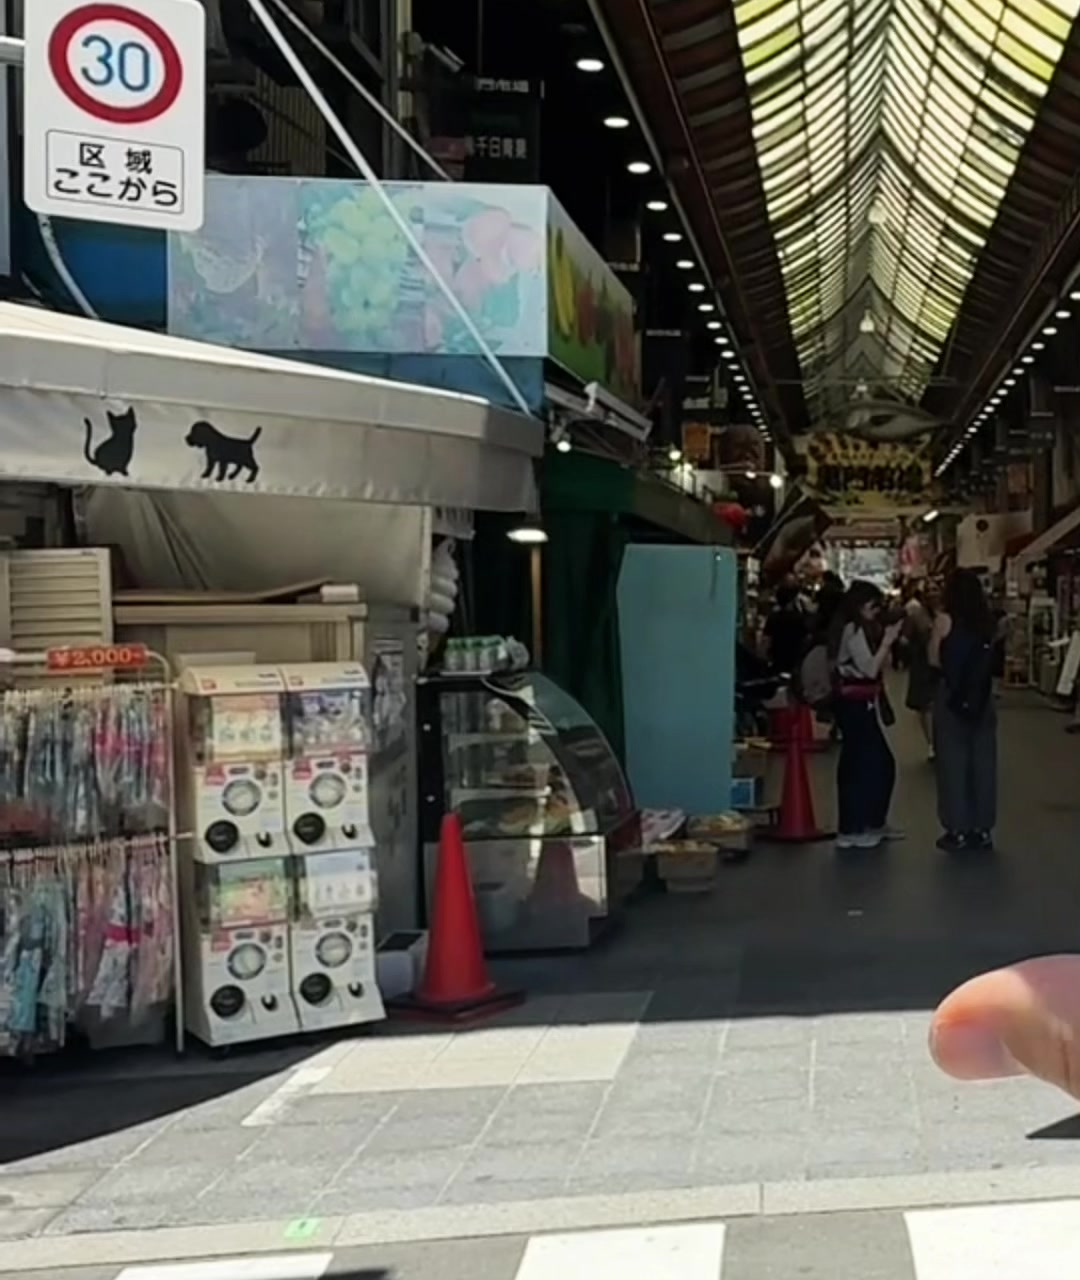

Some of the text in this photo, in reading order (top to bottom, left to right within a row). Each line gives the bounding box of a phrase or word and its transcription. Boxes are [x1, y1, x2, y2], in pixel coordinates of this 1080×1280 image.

[81, 35, 151, 92] 30
[53, 168, 179, 207] ここから
